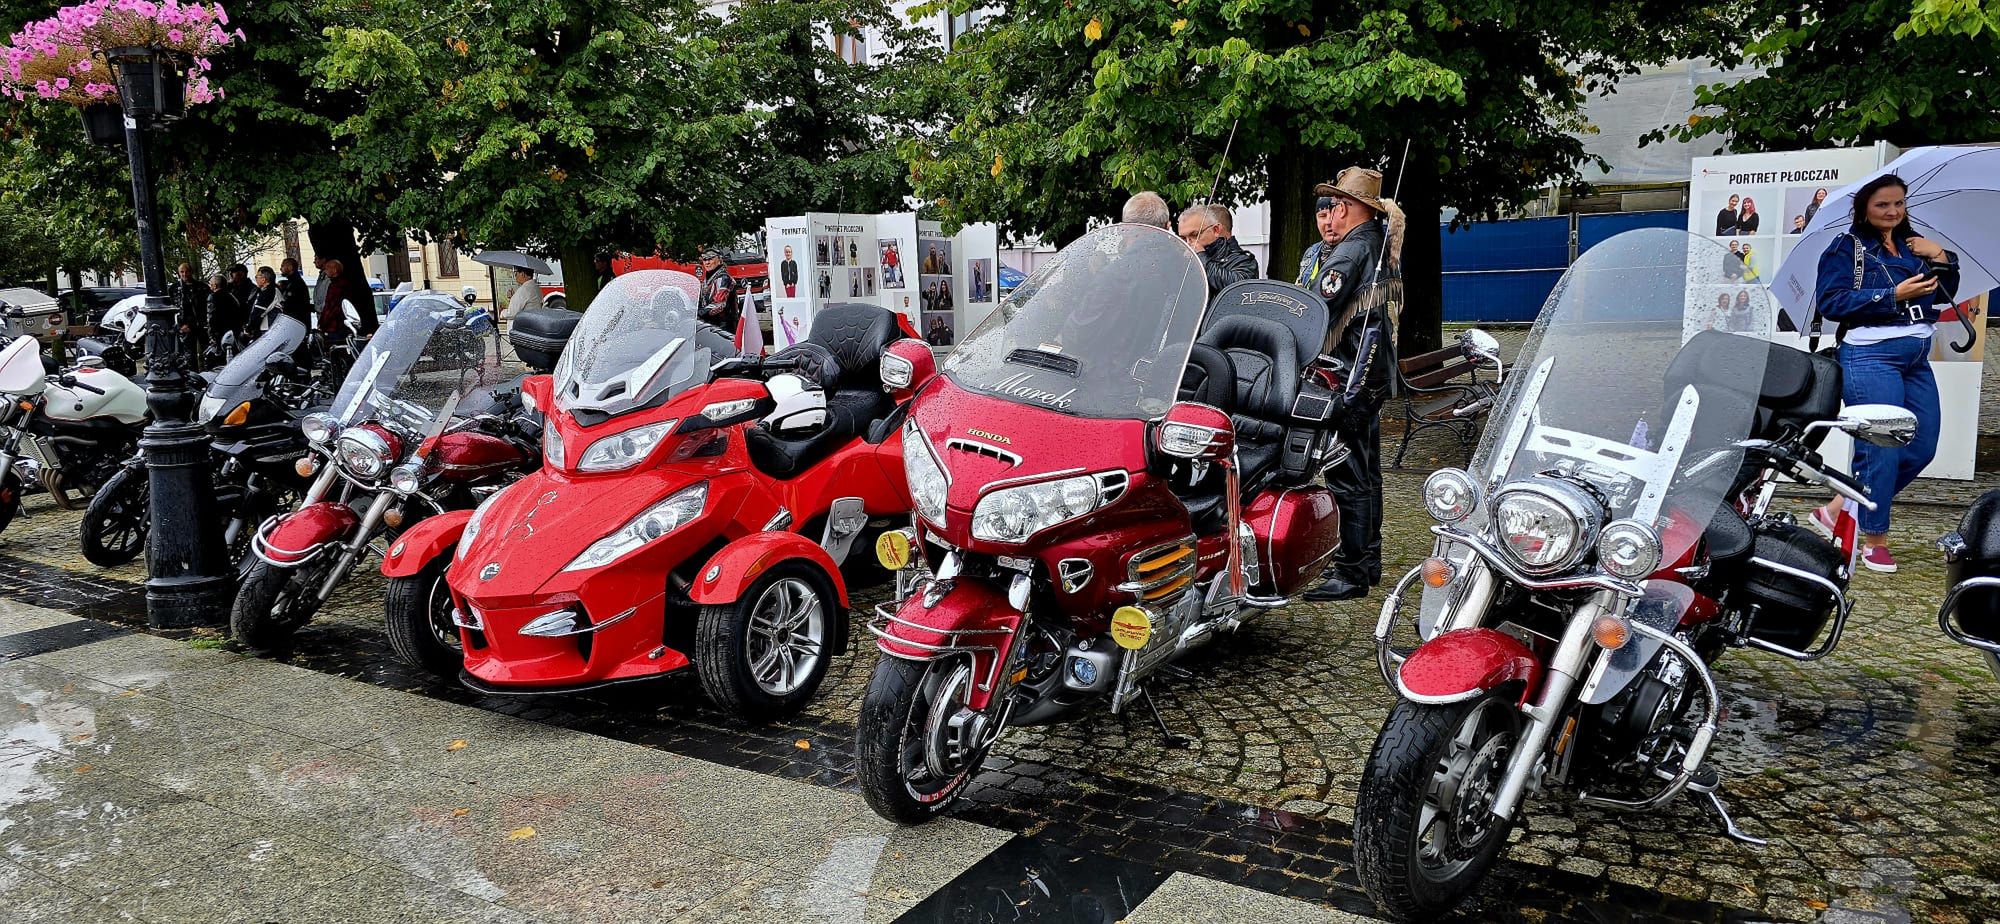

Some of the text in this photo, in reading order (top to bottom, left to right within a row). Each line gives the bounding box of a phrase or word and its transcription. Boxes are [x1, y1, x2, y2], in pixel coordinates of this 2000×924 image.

[1729, 169, 1839, 185] PORTRET PŁOCCZAN
[1853, 265, 1864, 290] GUESS
[980, 372, 1077, 409] Marek
[967, 428, 1011, 443] HONDA
